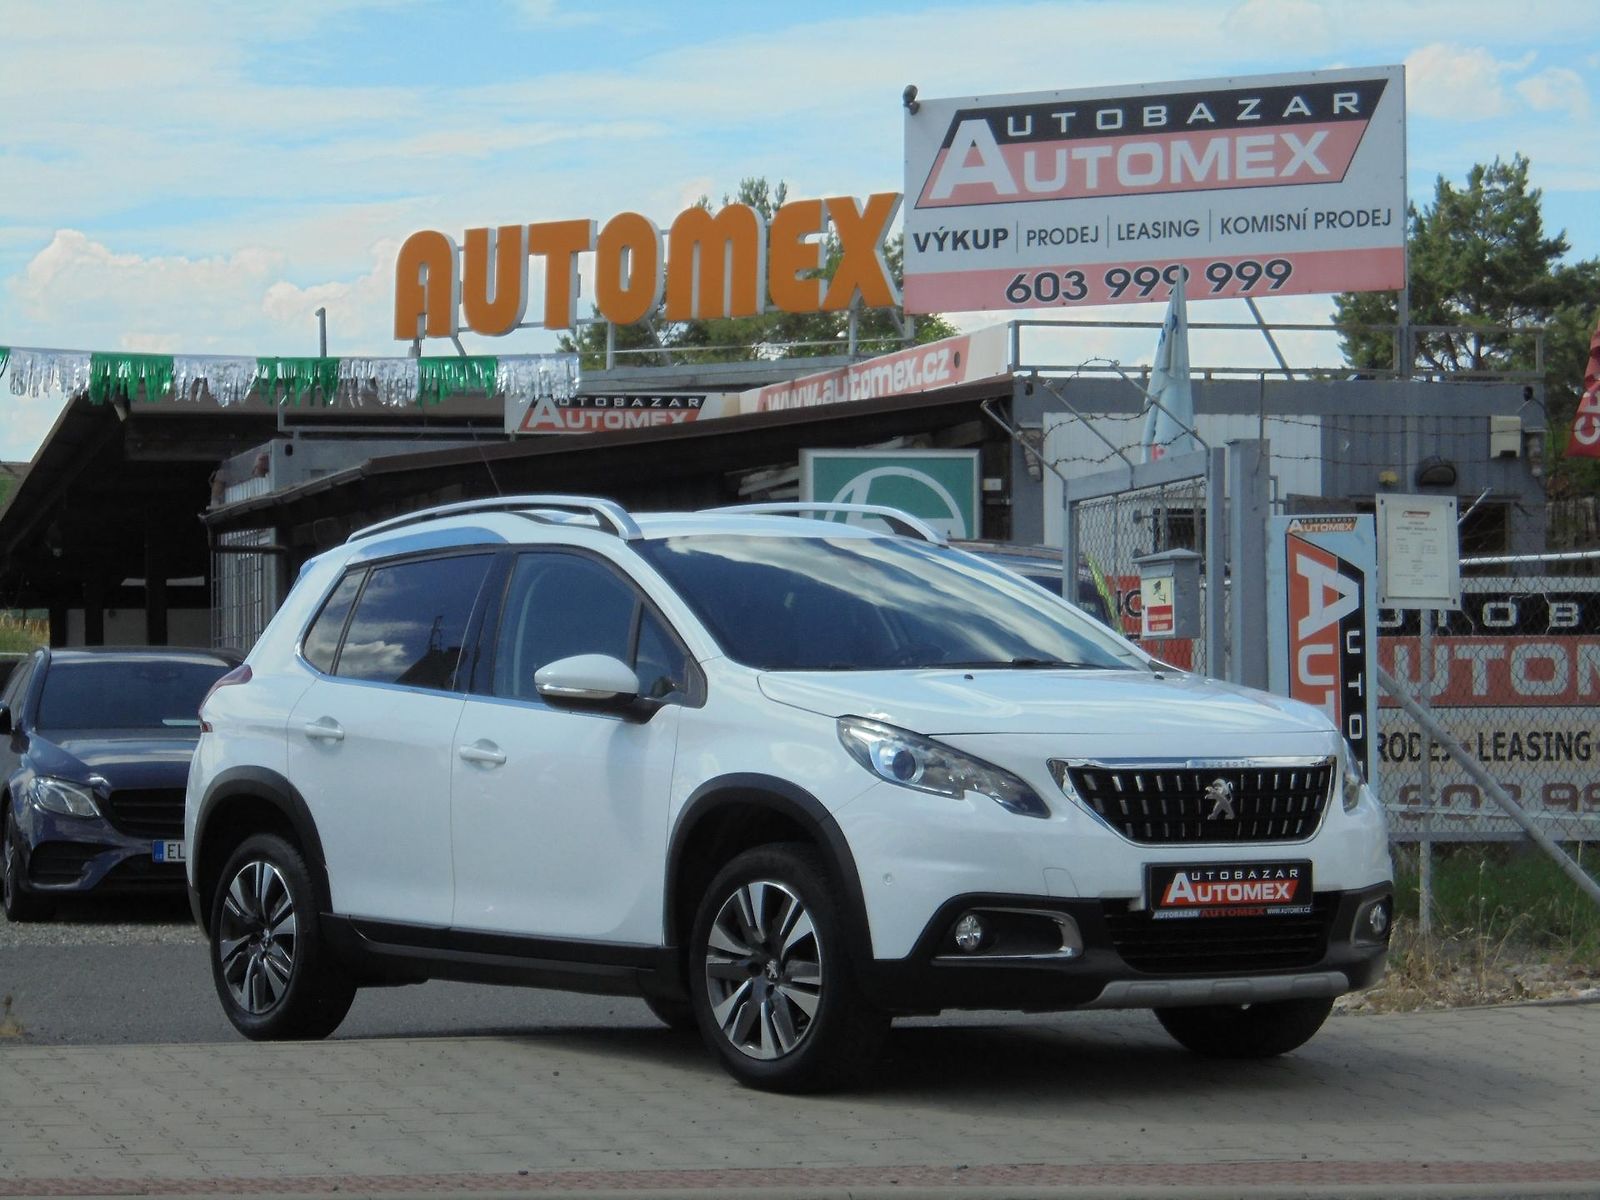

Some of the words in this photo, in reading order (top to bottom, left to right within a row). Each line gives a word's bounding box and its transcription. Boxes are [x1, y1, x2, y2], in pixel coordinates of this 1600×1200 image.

[929, 118, 1330, 200] AUTOMEX
[912, 227, 1009, 254] VÝKUP
[1026, 225, 1100, 248] PRODEJ
[1117, 219, 1200, 242] LEASING
[1220, 208, 1308, 236] KOMISNÍ
[1314, 208, 1393, 231] PRODEJ
[393, 191, 904, 341] AUTOMEX
[1006, 271, 1088, 304] 603
[1105, 264, 1190, 298] 999
[1205, 258, 1293, 293] 999
[767, 348, 950, 411] www.automex.cz
[1477, 730, 1592, 763] LEASING
[1166, 872, 1290, 903] AUTOMEX
